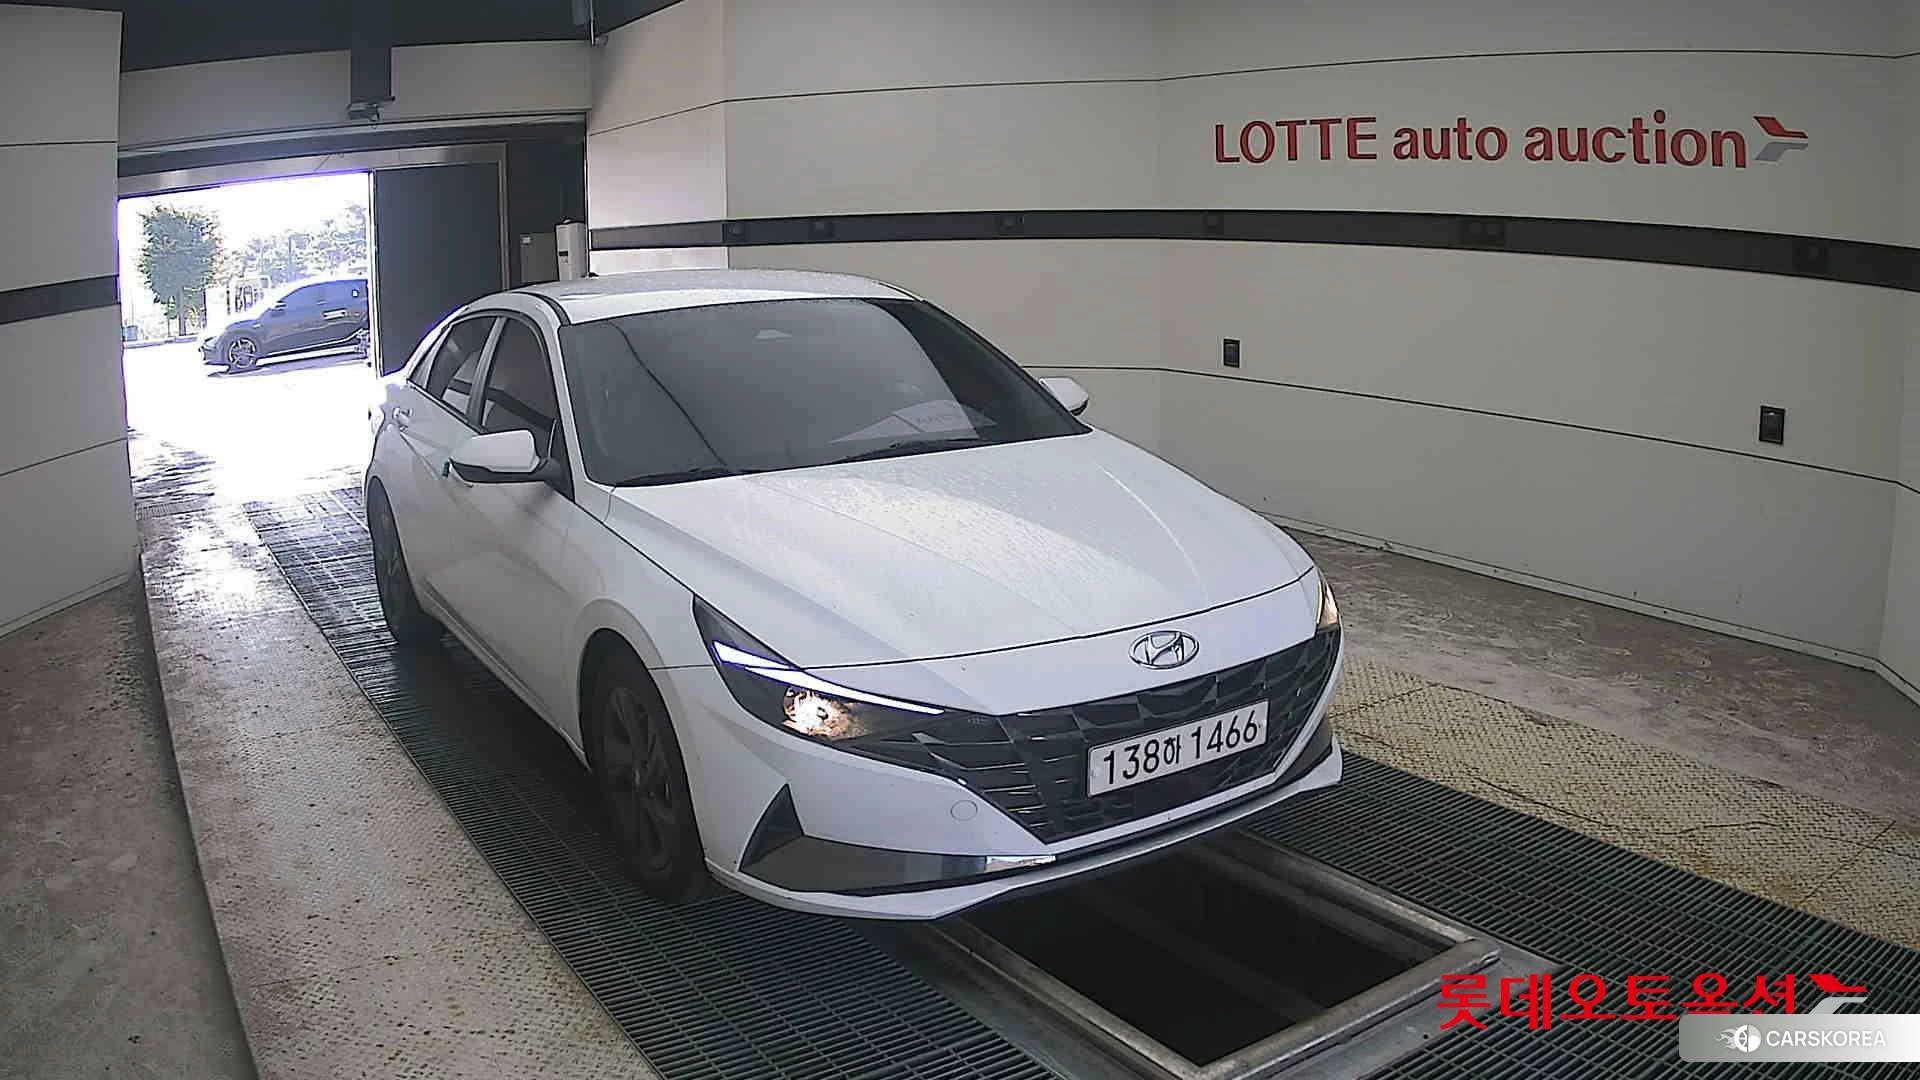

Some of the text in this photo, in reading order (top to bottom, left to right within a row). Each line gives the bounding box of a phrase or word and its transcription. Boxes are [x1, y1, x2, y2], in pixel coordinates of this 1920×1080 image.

[1215, 110, 1747, 169] LOTTE auto auction
[1103, 710, 1258, 784] 138하 1466
